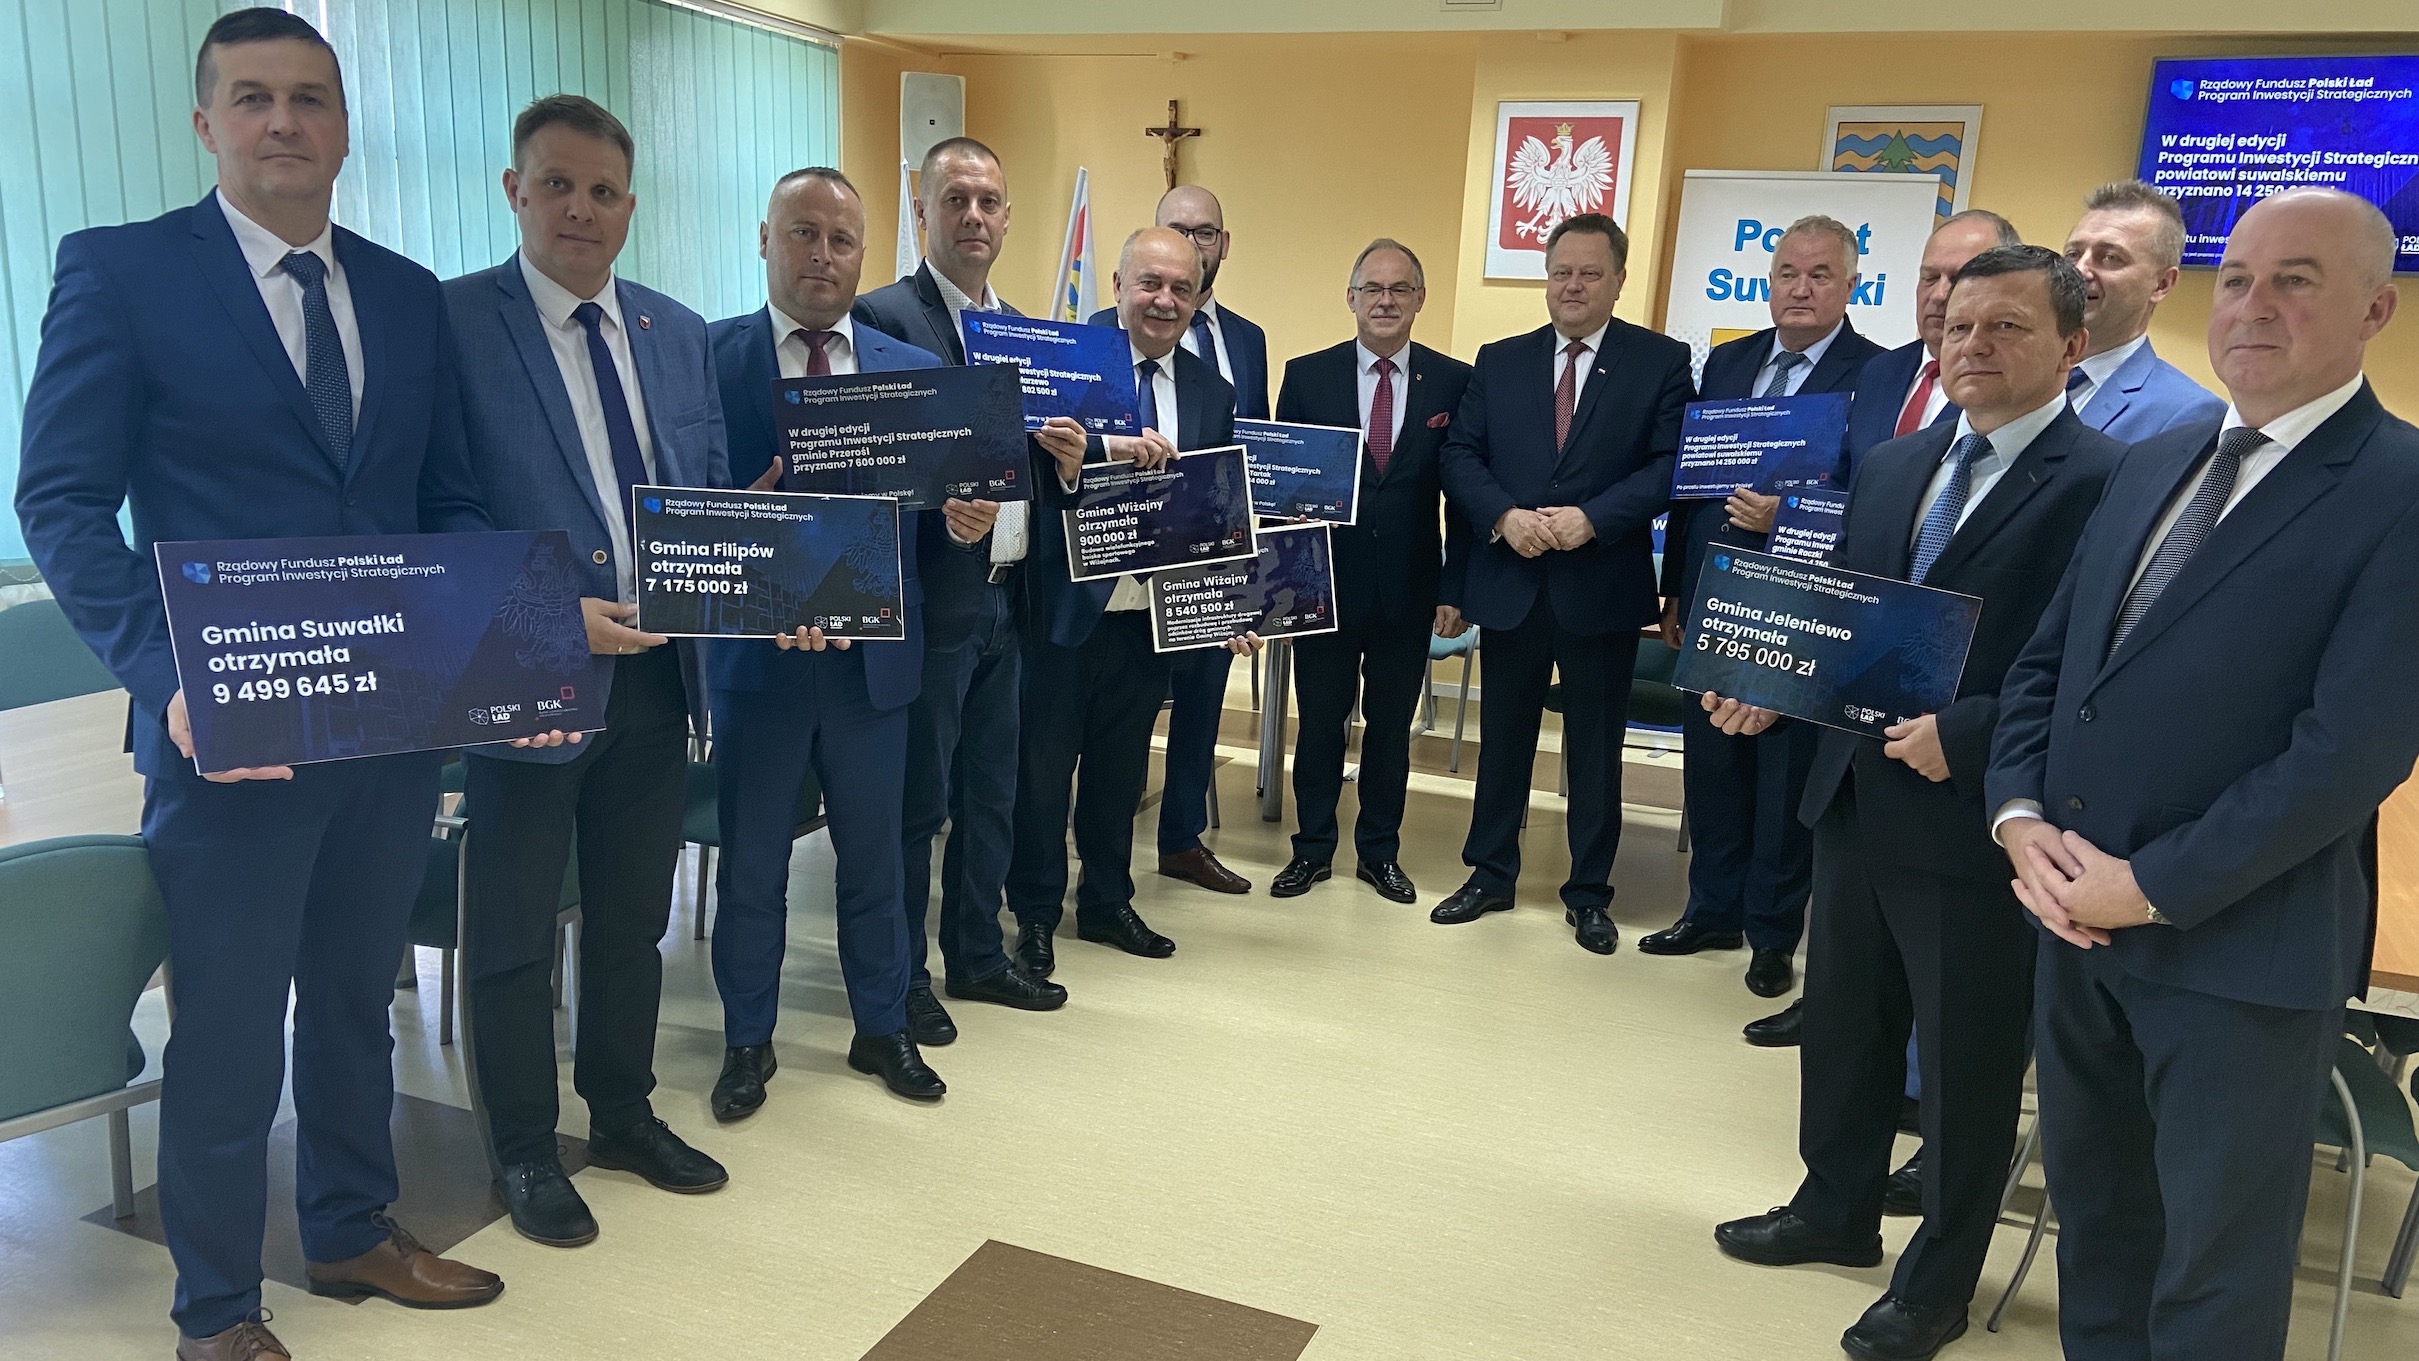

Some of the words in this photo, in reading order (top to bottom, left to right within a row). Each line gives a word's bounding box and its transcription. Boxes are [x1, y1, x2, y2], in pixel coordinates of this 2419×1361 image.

[2199, 79, 2253, 92] Rządowy
[2254, 78, 2306, 89] Fundusz
[2307, 77, 2347, 88] Polski
[2348, 77, 2373, 88] Ład
[2197, 90, 2250, 103] Program
[2252, 89, 2314, 102] Inwestycji
[2315, 88, 2412, 102] Strategicznych
[2161, 134, 2178, 147] W
[2179, 133, 2235, 151] drugiej
[2237, 133, 2287, 151] edycji
[2158, 151, 2236, 168] Programu
[2238, 150, 2322, 169] Inwestycji
[2323, 151, 2419, 168] Strategiczn
[2154, 167, 2236, 183] powiatowi
[2237, 168, 2346, 182] suwalskiemu
[2236, 185, 2252, 196] 14
[1734, 219, 1871, 255] Pot
[1706, 268, 1886, 306] Suki
[972, 351, 981, 360] W
[803, 388, 839, 397] Rządowy
[839, 386, 872, 394] Fundusz
[872, 383, 897, 392] Polski
[897, 382, 912, 390] Ład
[804, 397, 838, 405] Program
[839, 392, 878, 402] Inwestycji
[879, 388, 937, 399] Strategicznych
[788, 428, 799, 437] W
[800, 425, 837, 438] drugiej
[838, 422, 870, 435] edycji
[790, 438, 842, 451] Programu
[843, 432, 895, 447] Inwestycji
[896, 427, 972, 441] Strategicznych
[1684, 444, 1716, 452] Programu
[1717, 441, 1752, 450] Inwestycji
[1753, 440, 1806, 449] Strategicznych
[1693, 435, 1716, 444] drugiej
[1717, 434, 1738, 442] edycji
[792, 450, 827, 464] gminie
[829, 446, 869, 458] Przerośl
[1682, 452, 1716, 461] powiatowi
[1717, 450, 1762, 458] suwalskiemu
[793, 461, 846, 474] przyznano
[847, 458, 853, 467] 7
[855, 457, 874, 467] 600
[876, 455, 896, 465] 000
[896, 454, 906, 464] zł
[1272, 465, 1321, 475] Strategicznych
[1681, 460, 1715, 469] przyznano
[665, 499, 704, 510] Rządowy
[706, 501, 742, 509] Fundusz
[743, 502, 769, 510] Polski
[770, 503, 787, 511] Ład
[1076, 505, 1114, 519] Gmina
[1117, 499, 1163, 515] Wiżajny
[665, 507, 704, 517] Program
[706, 509, 749, 520] Inwestycji
[750, 511, 813, 523] Strategicznych
[1078, 515, 1138, 533] otrzymała
[1079, 534, 1101, 546] 900
[1102, 531, 1125, 543] 000
[1127, 529, 1137, 540] zł
[1775, 535, 1811, 546] Programu
[1786, 528, 1813, 539] drugiej
[1813, 532, 1836, 542] edycji
[649, 541, 709, 556] Gmina
[713, 542, 774, 561] Filipów
[217, 560, 277, 574] Rządowy
[281, 558, 335, 569] Fundusz
[338, 556, 377, 567] Polski
[379, 555, 403, 565] Ład
[651, 559, 742, 578] otrzymała
[219, 574, 279, 585] Program
[282, 568, 348, 582] Inwestycji
[350, 564, 444, 579] Strategicznych
[1162, 579, 1200, 592] Gmina
[1203, 574, 1248, 589] Wiżajny
[1733, 559, 1771, 576] Rządowy
[1771, 566, 1807, 581] Fundusz
[1807, 573, 1836, 586] Polski
[1835, 579, 1854, 590] Ład
[645, 578, 657, 591] 7
[662, 578, 695, 593] 175
[697, 579, 730, 594] 000
[733, 580, 748, 594] zł
[1731, 566, 1768, 581] Program
[1768, 574, 1812, 592] Inwestycji
[1812, 583, 1879, 604] Strategicznych
[1164, 587, 1223, 605] otrzymała
[1165, 607, 1173, 617] 8
[1175, 605, 1197, 616] 540
[1200, 602, 1222, 613] 500
[1224, 600, 1234, 611] zł
[862, 616, 880, 624] BGK
[1706, 597, 1763, 621] Gmina
[1764, 610, 1852, 640] Jeleniewo
[202, 622, 296, 645] Gmina
[300, 612, 404, 638] Suwałki
[1702, 617, 1788, 646] otrzymała
[208, 644, 350, 674] otrzymała
[1696, 633, 1710, 650] 5
[1715, 636, 1751, 660] 795
[1755, 647, 1793, 670] 000
[1796, 659, 1816, 676] zł
[212, 683, 230, 704] 9
[237, 678, 290, 701] 499
[296, 673, 349, 696] 645
[354, 671, 377, 692] zł
[490, 704, 521, 714] POLSKI
[537, 699, 562, 710] BGK
[1861, 708, 1885, 718] POLSKI
[492, 713, 510, 721] ŁAD
